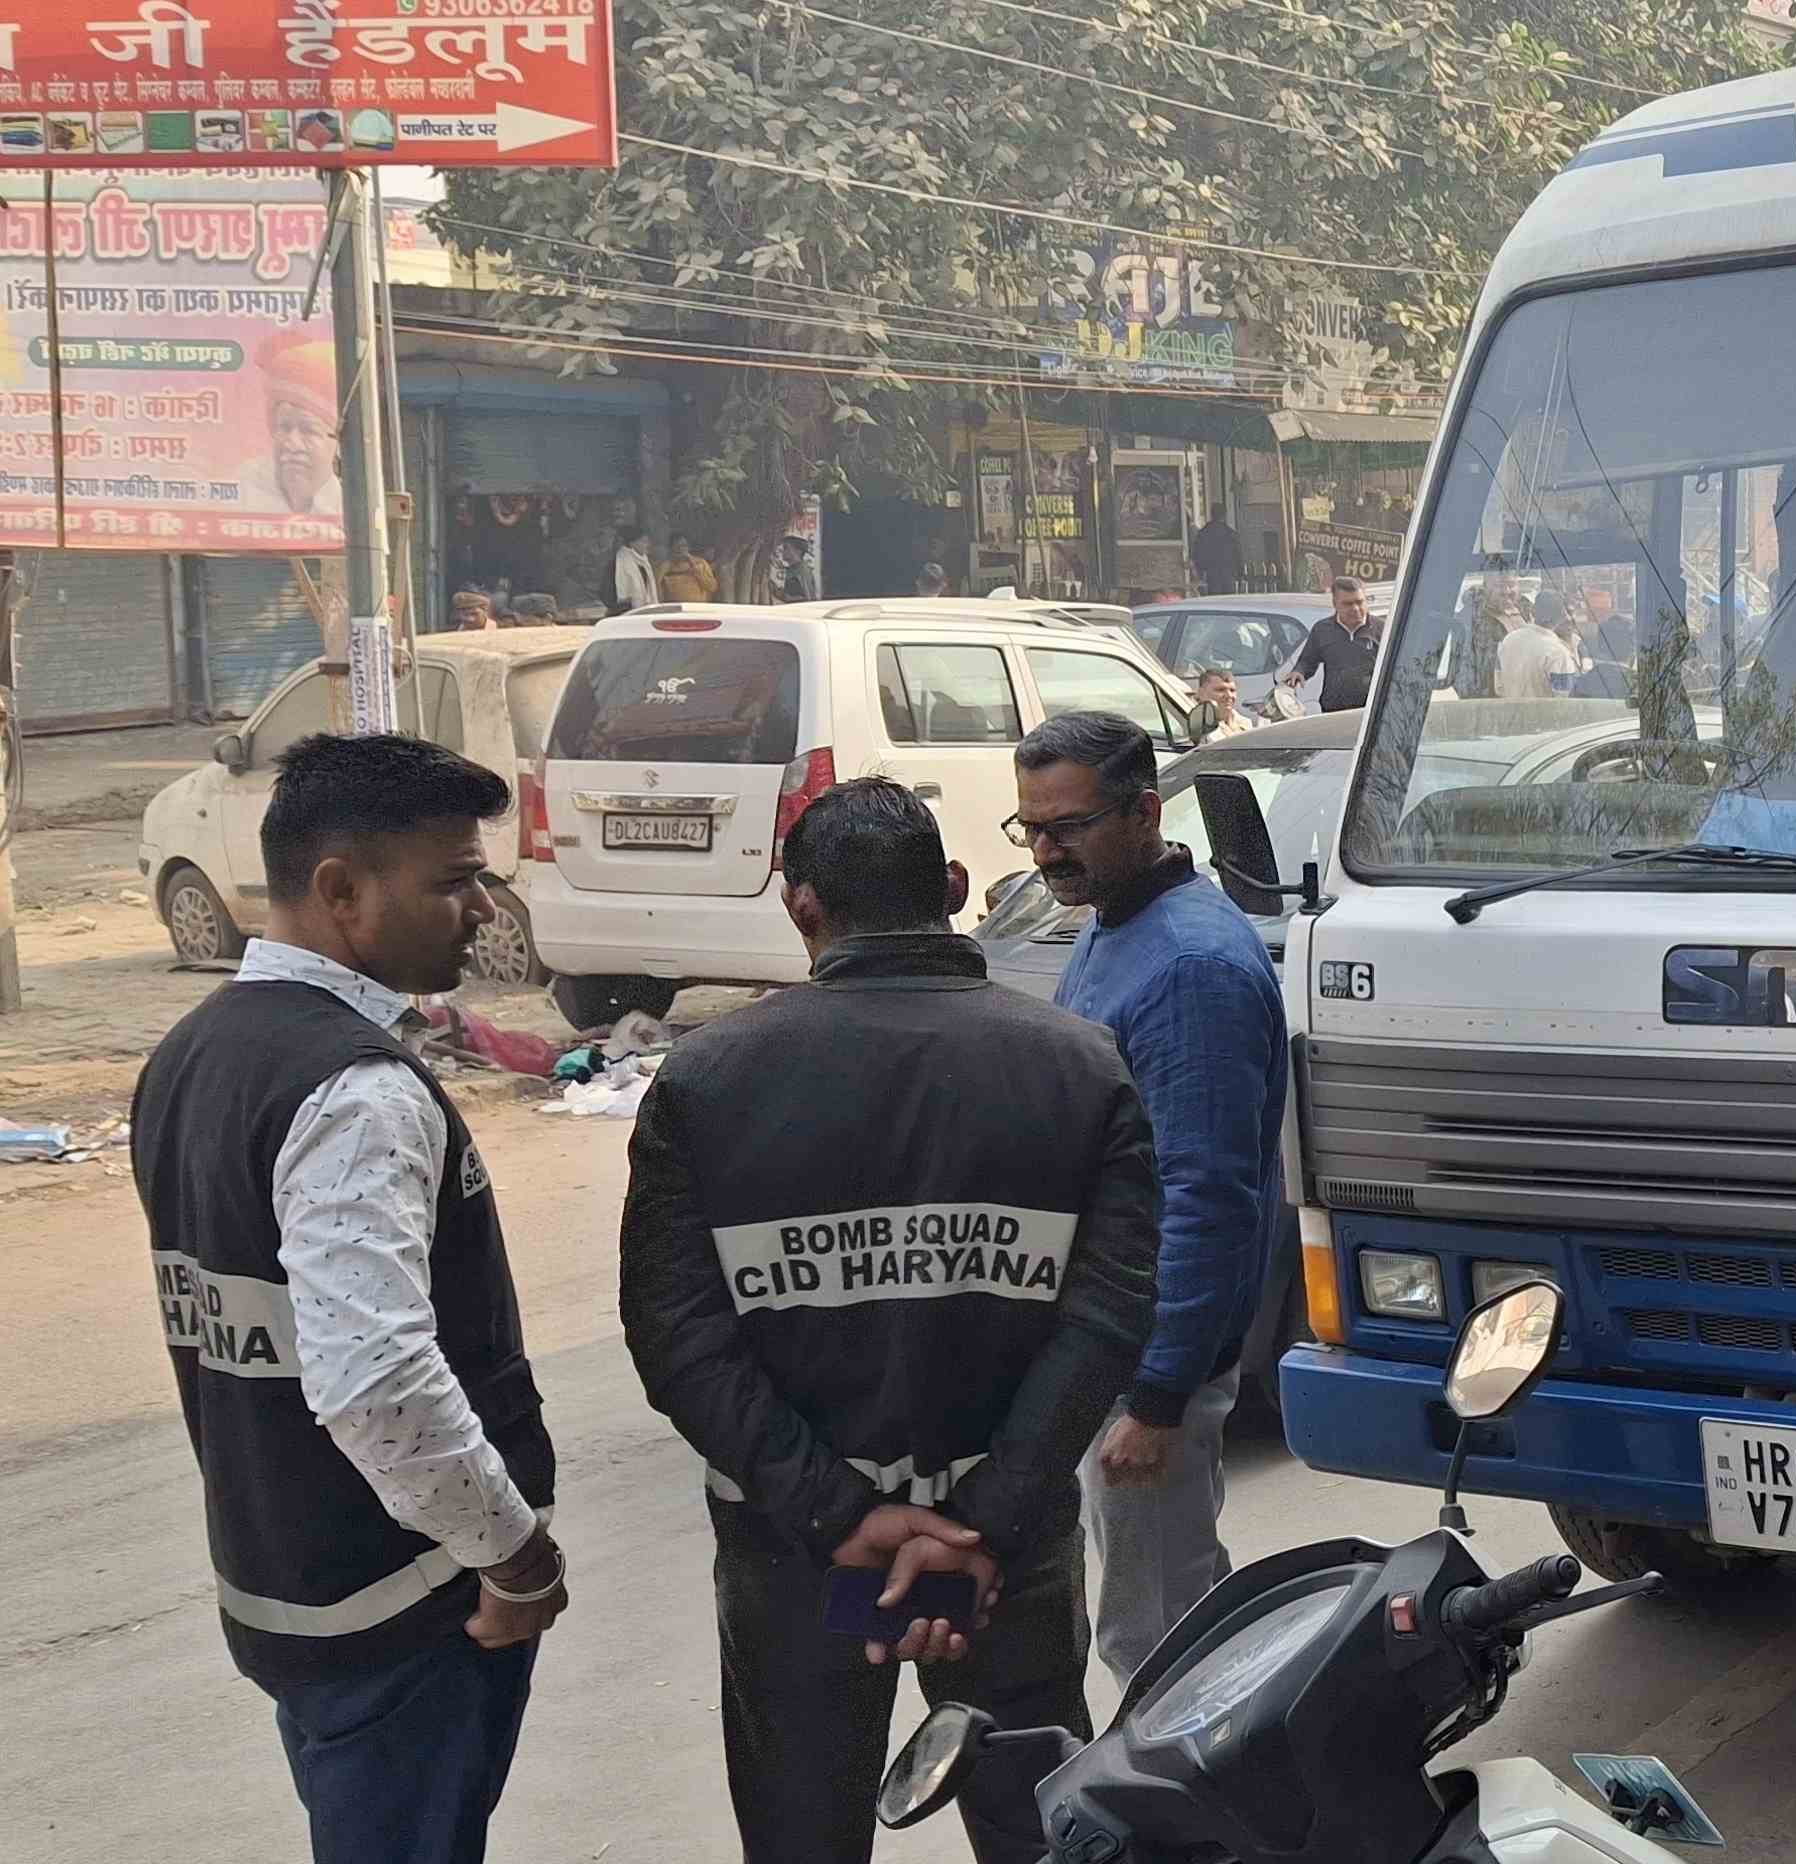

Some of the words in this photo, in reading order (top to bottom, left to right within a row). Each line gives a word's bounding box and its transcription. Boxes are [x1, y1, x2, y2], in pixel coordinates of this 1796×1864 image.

[86, 2, 210, 68] जी
[401, 120, 452, 136] पानीपत
[457, 125, 475, 136] रेट
[478, 123, 497, 136] पर
[1345, 559, 1388, 580] HOT
[614, 820, 707, 843] DL2CAU8427
[779, 1216, 893, 1255] BOMB
[903, 1213, 1020, 1246] SQUAD
[734, 1259, 820, 1298] CID
[841, 1247, 1057, 1291] HARYANA
[1716, 1476, 1737, 1490] IND
